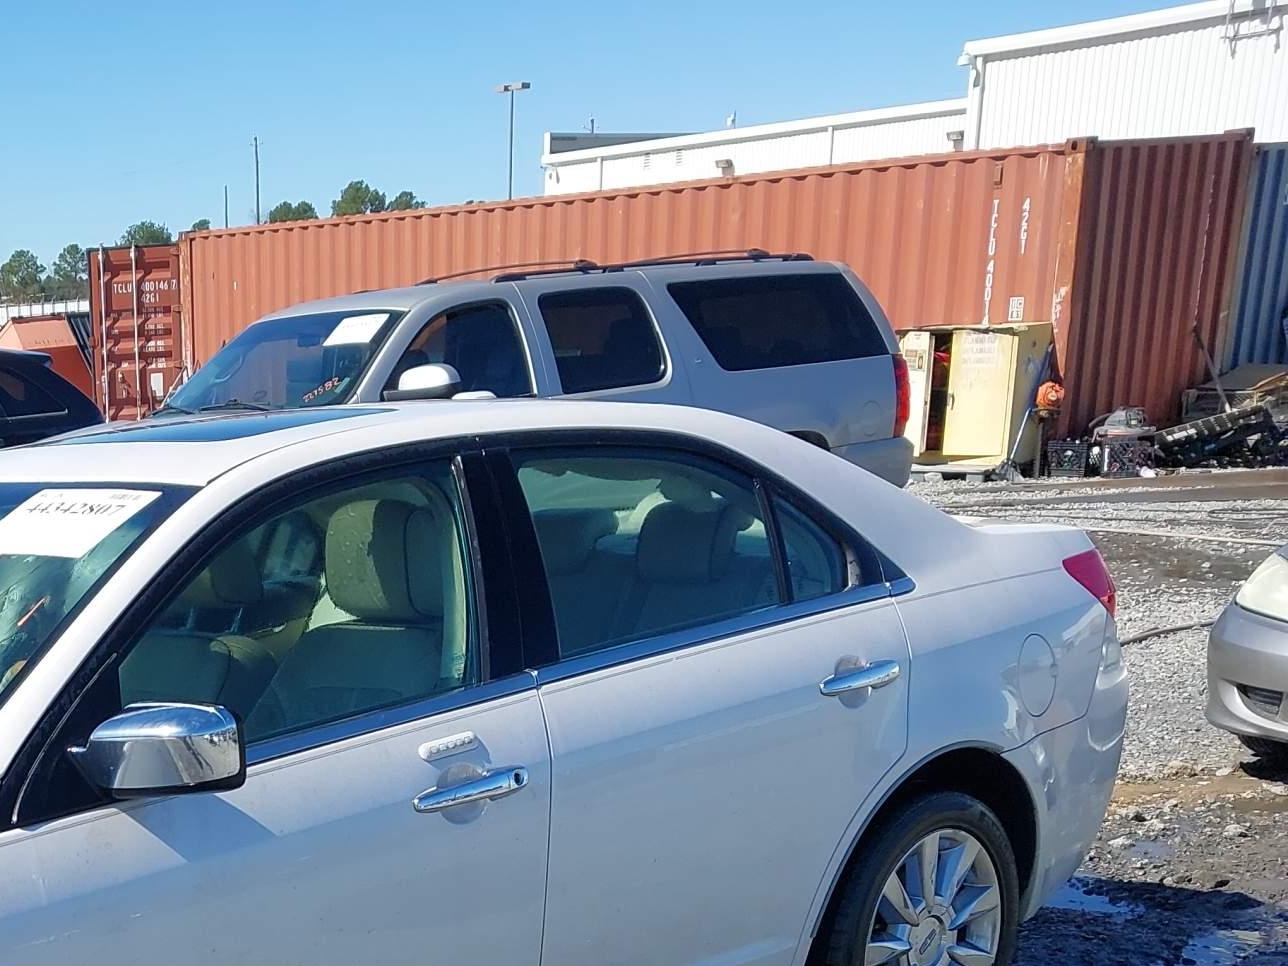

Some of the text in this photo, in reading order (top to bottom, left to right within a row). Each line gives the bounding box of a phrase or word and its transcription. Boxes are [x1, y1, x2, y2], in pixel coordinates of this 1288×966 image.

[988, 199, 1000, 256] TCLU
[1020, 196, 1031, 255] 42G1
[113, 283, 132, 295] TCLU
